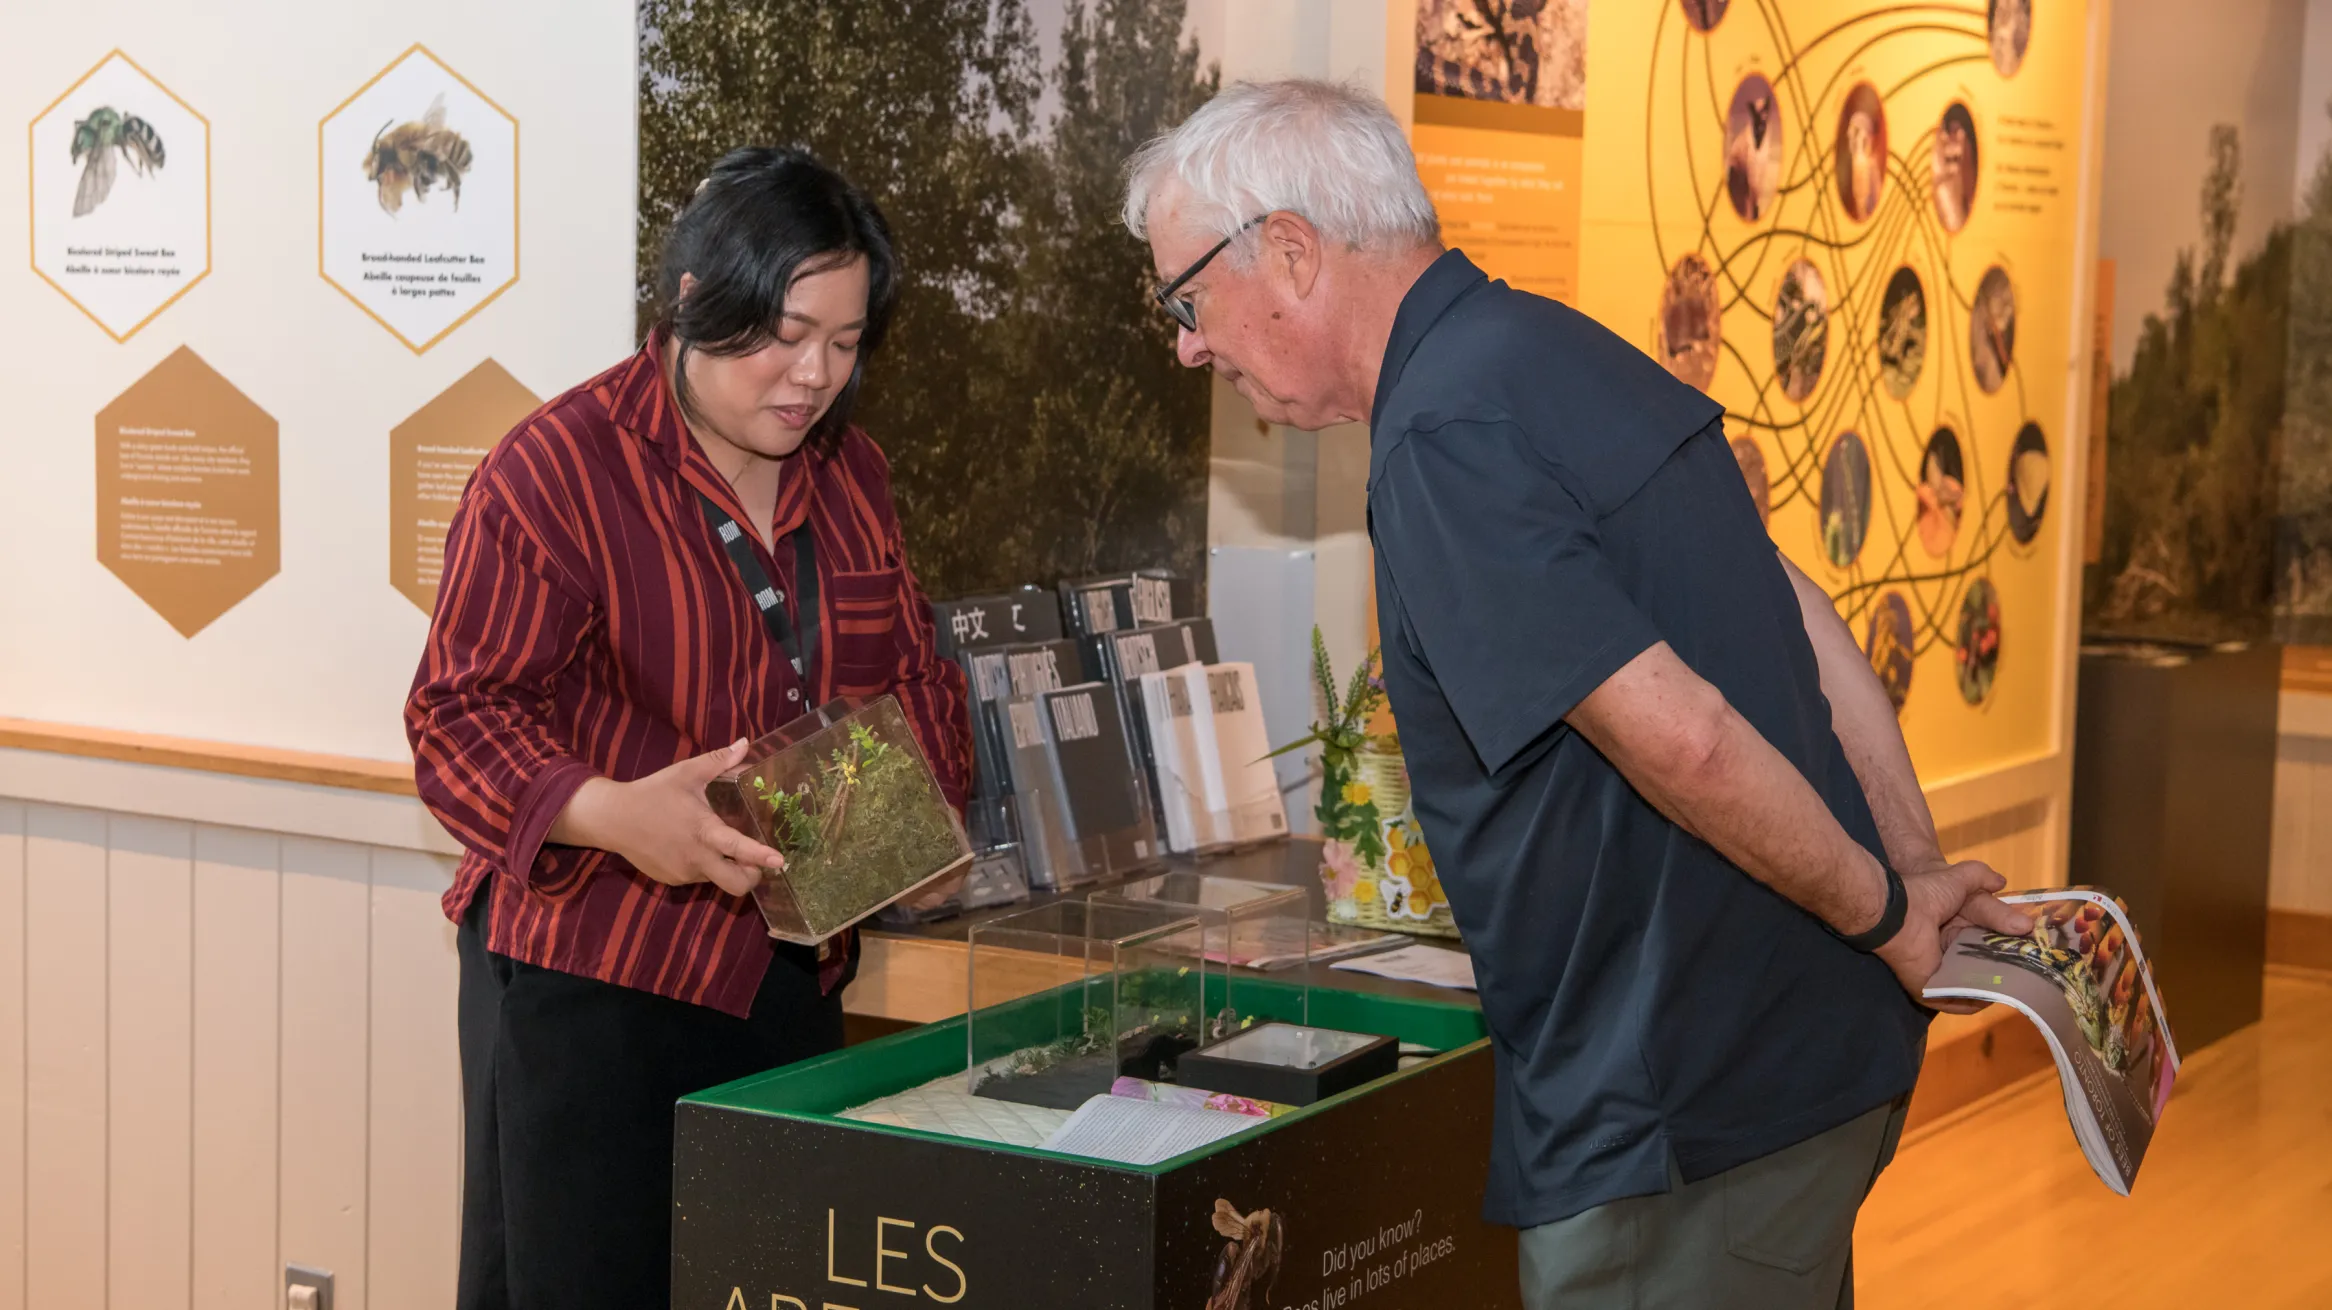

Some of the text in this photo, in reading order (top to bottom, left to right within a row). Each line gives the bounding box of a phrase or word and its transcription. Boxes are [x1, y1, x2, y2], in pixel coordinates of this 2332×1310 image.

[469, 254, 485, 264] Bee
[363, 271, 393, 282] Abeille
[438, 272, 448, 283] de
[717, 519, 743, 545] ROM
[754, 586, 779, 612] ROM
[951, 605, 990, 645] 中文
[2074, 1050, 2106, 1121] TORONTO
[2103, 1122, 2116, 1141] OF
[2114, 1142, 2133, 1177] BEES
[827, 1207, 967, 1303] LES
[1322, 1208, 1423, 1278] Did you know?
[1323, 1235, 1456, 1310] live in lots of places.
